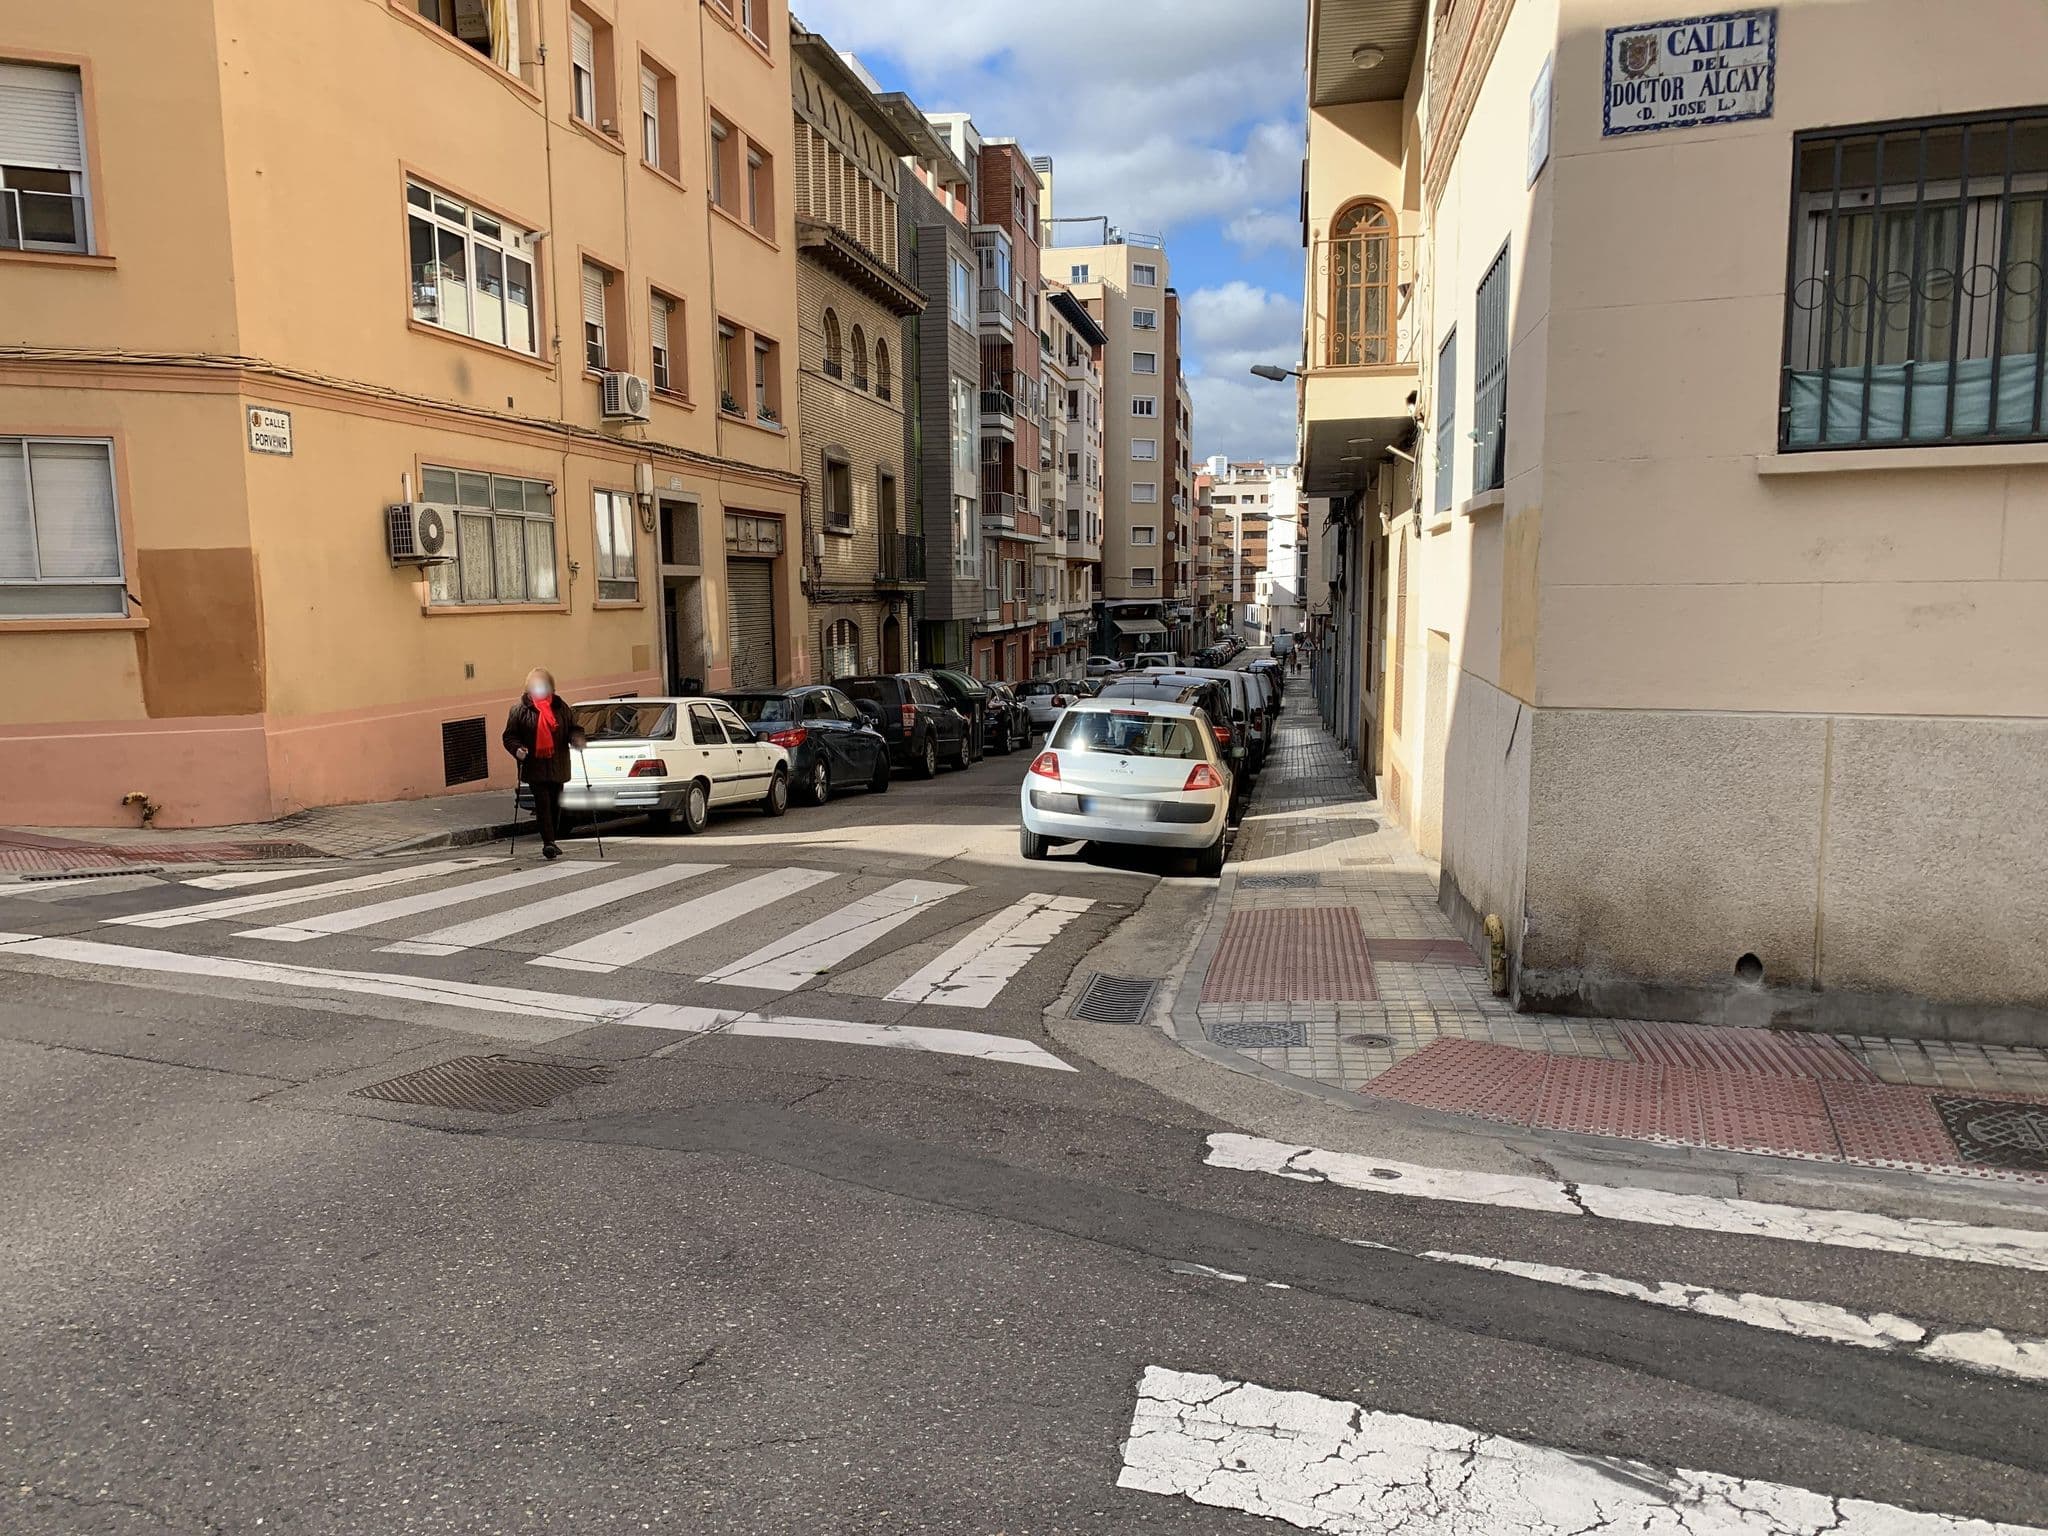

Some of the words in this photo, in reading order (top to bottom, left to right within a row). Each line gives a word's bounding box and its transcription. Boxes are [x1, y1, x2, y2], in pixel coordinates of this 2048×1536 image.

[1667, 19, 1763, 57] CALLE
[1691, 54, 1729, 73] DEL
[1612, 76, 1685, 107] DOCTOR
[1699, 65, 1767, 98] ALCAY
[1668, 100, 1707, 119] JOSE
[264, 417, 286, 429] CALLE
[255, 433, 288, 449] PORVENIR
